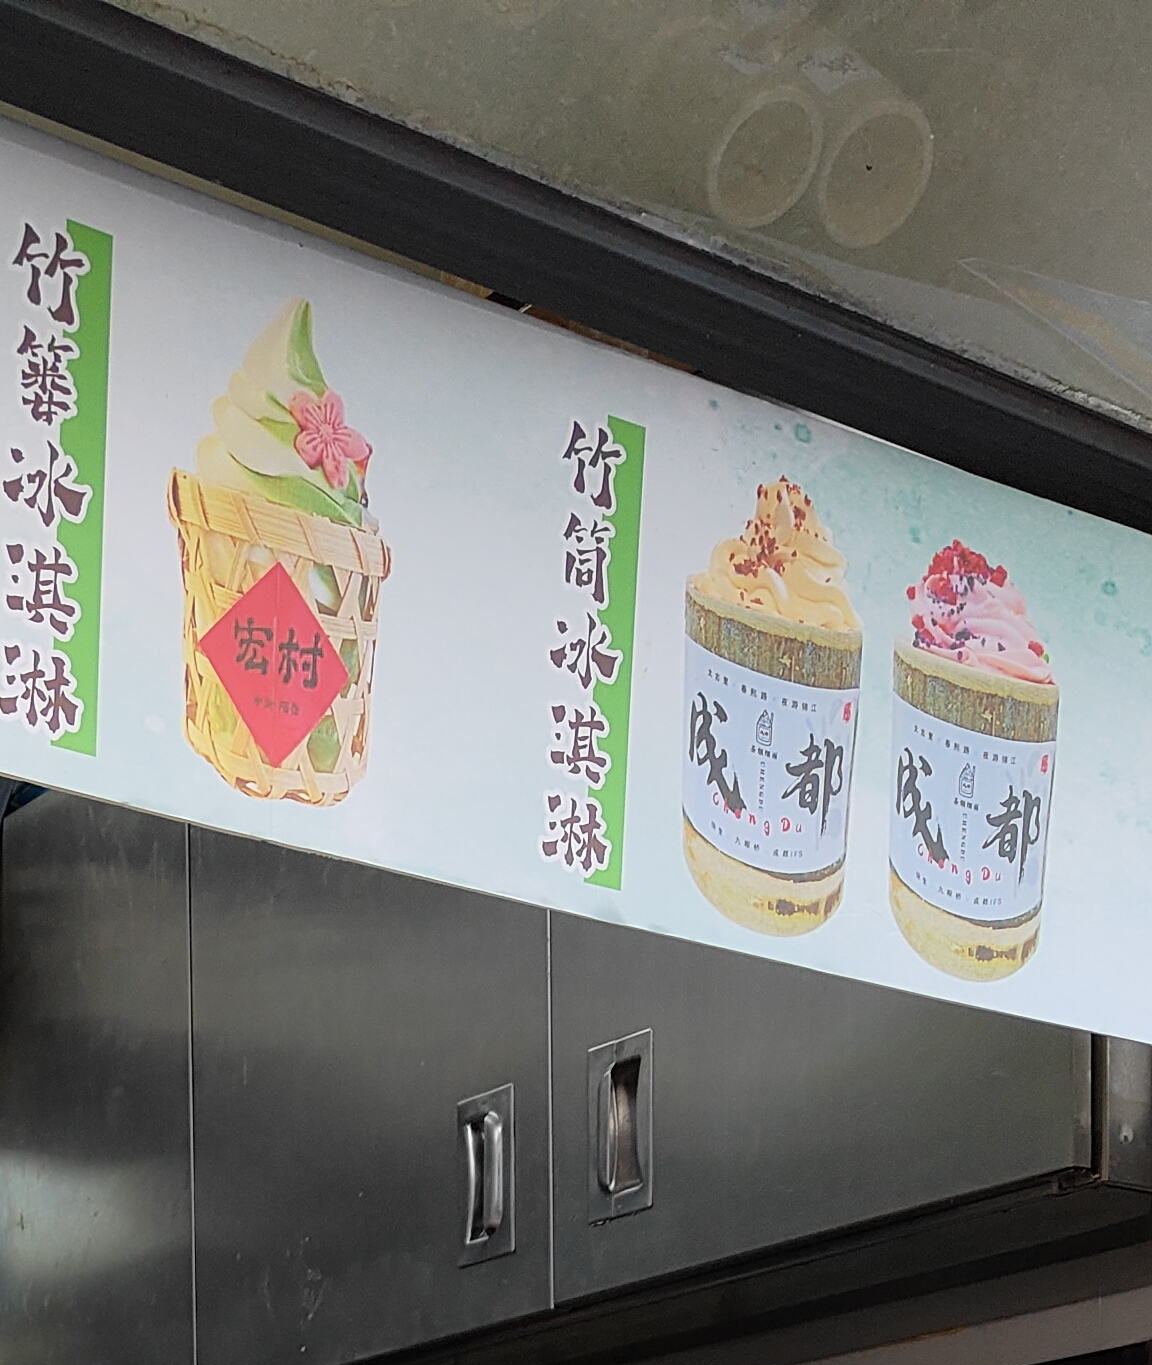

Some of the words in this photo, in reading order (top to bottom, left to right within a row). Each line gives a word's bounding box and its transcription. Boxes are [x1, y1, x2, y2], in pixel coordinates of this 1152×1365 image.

[234, 617, 324, 690] 宏村
[541, 420, 623, 873] 竹筒冰淇淋
[689, 691, 844, 837] 成都
[896, 747, 1042, 886] 成都
